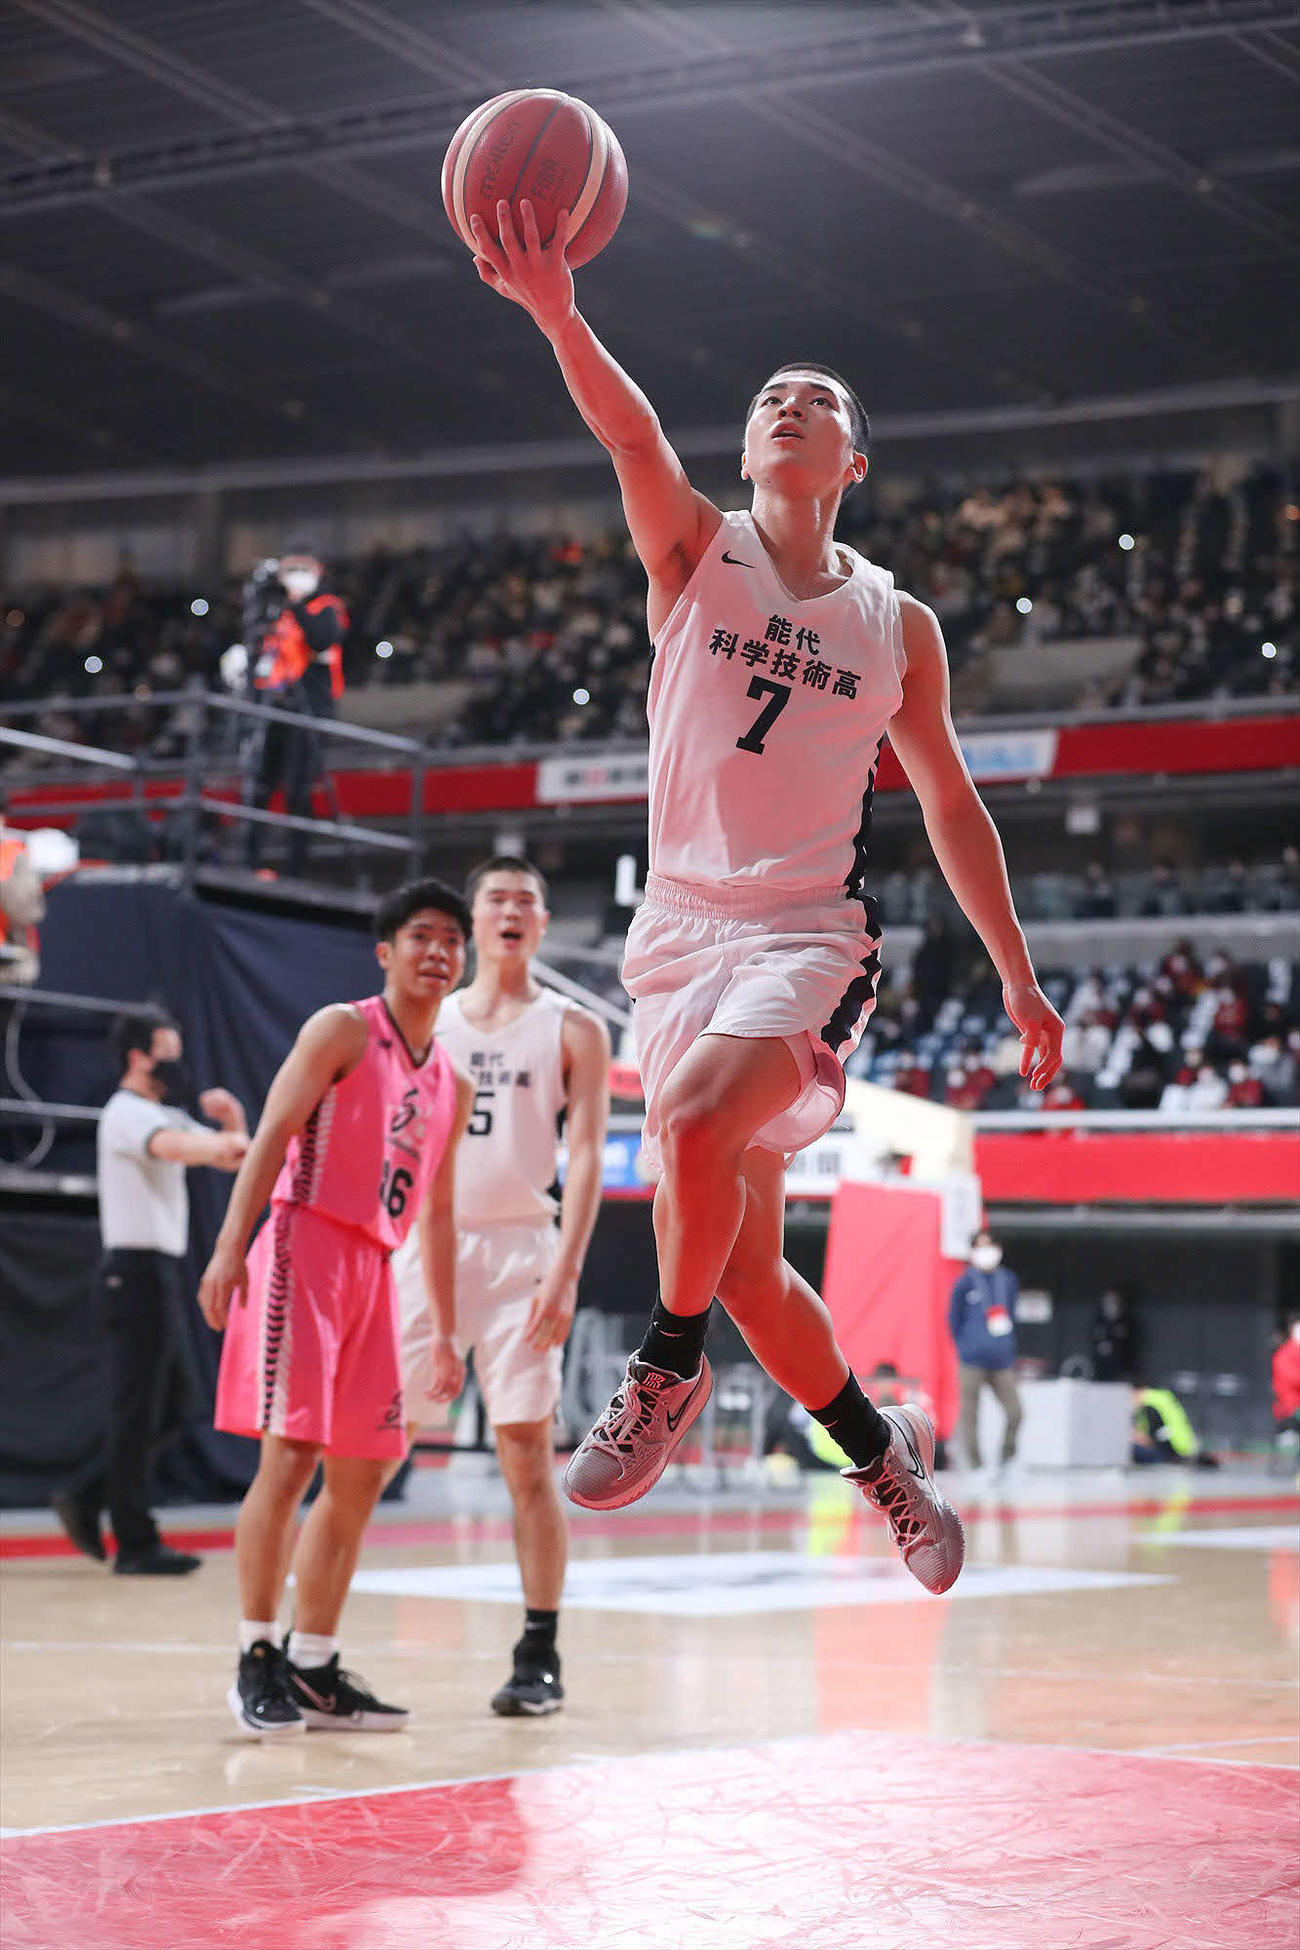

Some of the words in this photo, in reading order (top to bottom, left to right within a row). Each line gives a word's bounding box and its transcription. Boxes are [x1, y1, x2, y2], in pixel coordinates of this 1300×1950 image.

[764, 614, 821, 655] 能代
[709, 629, 862, 700] 科学技術高
[736, 675, 792, 755] 7
[468, 1091, 495, 1136] 5
